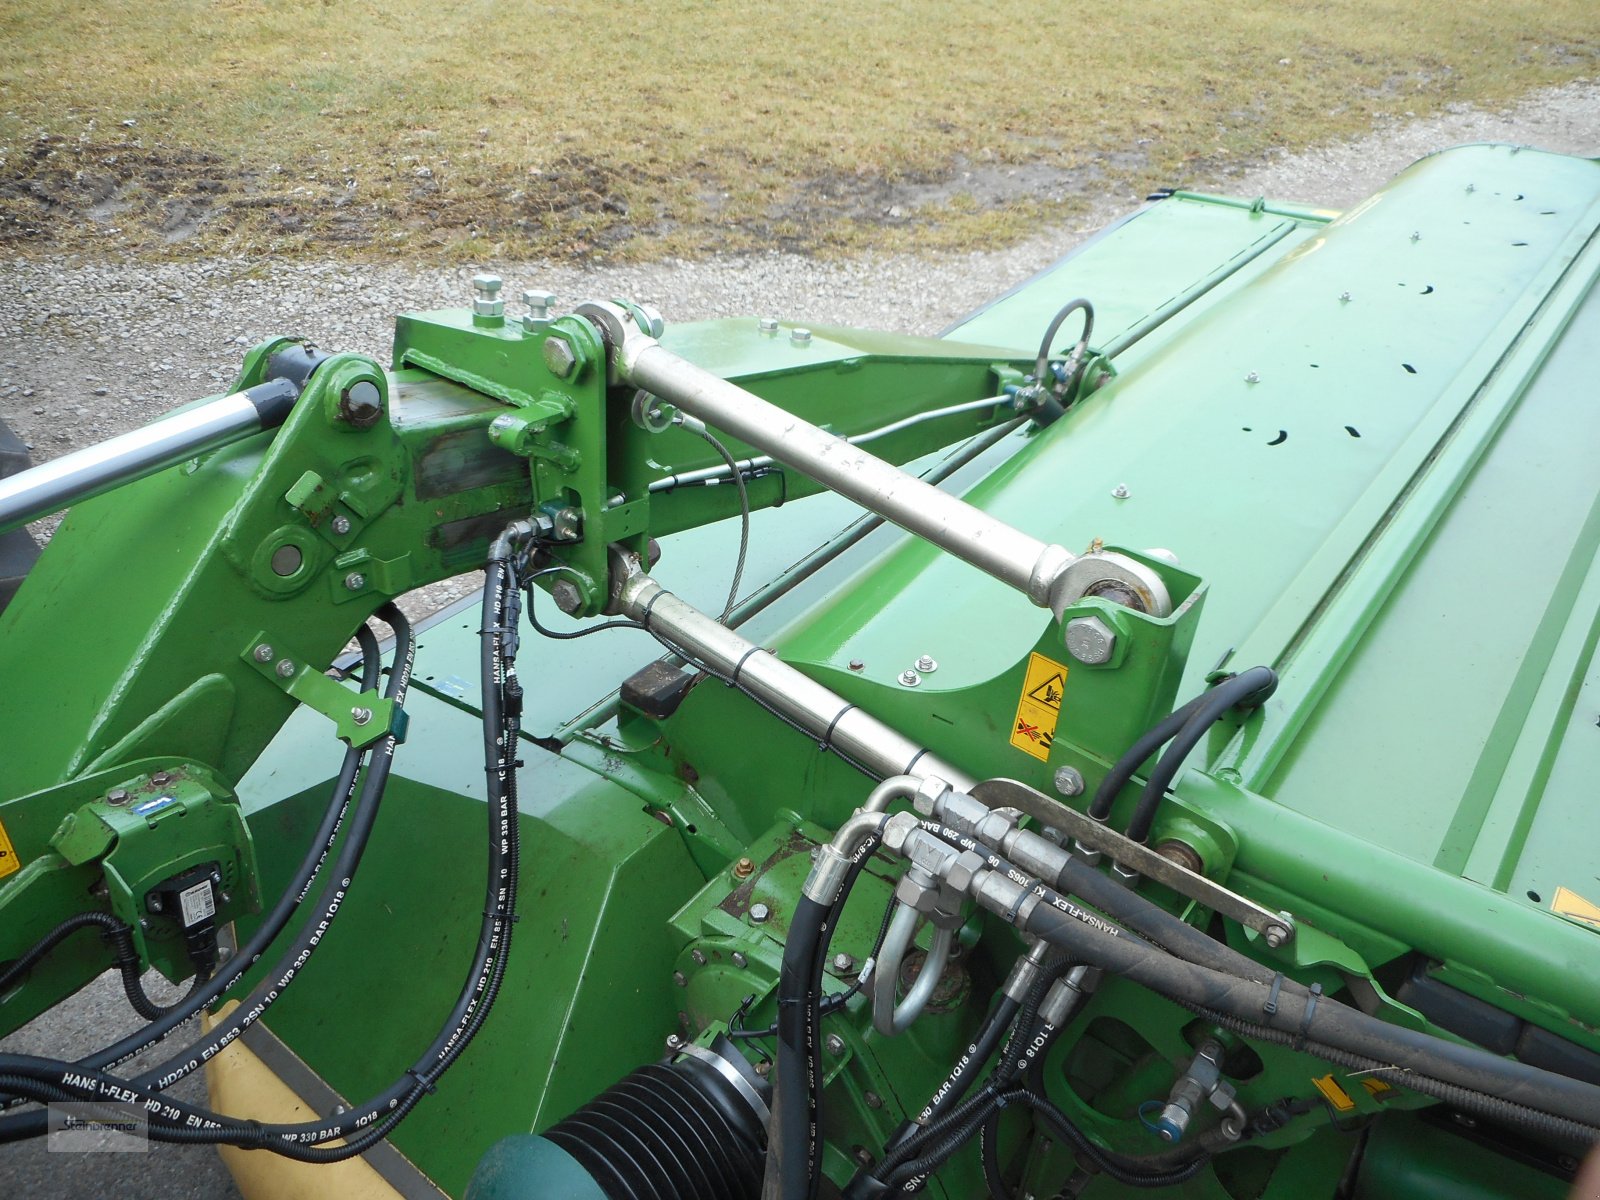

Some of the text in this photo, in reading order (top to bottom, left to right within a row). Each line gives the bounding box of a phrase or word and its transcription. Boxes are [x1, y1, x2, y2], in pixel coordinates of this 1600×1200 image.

[494, 602, 502, 615] HD
[492, 622, 501, 684] HANSA-FLX
[500, 795, 508, 817] BAR
[942, 827, 960, 842] 290
[501, 839, 509, 855] WP
[960, 838, 978, 852] WP
[987, 855, 1000, 868] 06
[501, 868, 508, 879] 10
[1052, 896, 1119, 938] HANSA-FLEX
[494, 918, 502, 933] 85
[490, 935, 499, 949] EN
[483, 957, 494, 975] 210
[158, 891, 345, 1089] HD210 EN 853 2SN 10 WP 330 BAR 1Q18
[477, 976, 487, 992] HD
[439, 998, 478, 1060] HANSA-FLEX
[932, 1080, 952, 1105] BAR
[949, 1055, 970, 1081] 1Q18
[144, 1098, 162, 1113] HD
[161, 1106, 181, 1120] 210
[186, 1114, 204, 1129] EN
[300, 1131, 317, 1143] 330
[319, 1126, 341, 1140] BAR
[355, 1111, 378, 1128] 1Q18
